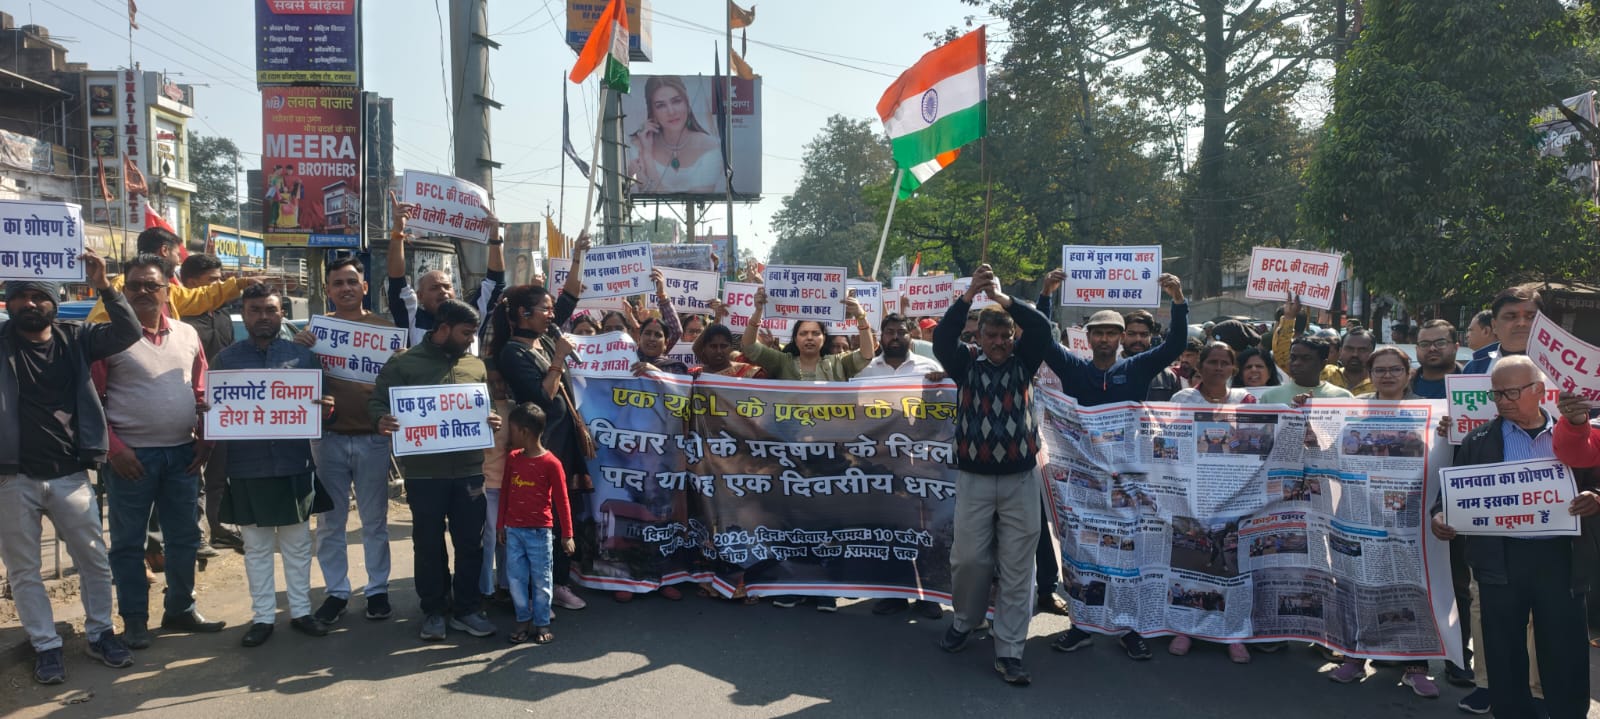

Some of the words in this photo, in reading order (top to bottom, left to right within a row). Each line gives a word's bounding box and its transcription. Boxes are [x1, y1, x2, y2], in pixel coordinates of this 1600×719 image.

[266, 134, 356, 159] MEERA
[298, 162, 356, 178] BROTHERS
[416, 182, 444, 200] BFCL
[446, 186, 457, 202] की
[3, 218, 22, 235] का
[24, 214, 64, 236] शोषण
[64, 216, 76, 237] हैं
[0, 250, 19, 268] का
[22, 251, 64, 275] प्रदूषण
[64, 248, 76, 269] हैं
[1070, 252, 1084, 262] हवा
[1088, 250, 1096, 261] में
[1097, 252, 1112, 265] घुल
[1115, 252, 1132, 262] गया
[1135, 252, 1155, 262] जहर
[598, 266, 620, 277] इसका
[621, 262, 645, 275] BFCL
[1094, 267, 1106, 280] जो
[1108, 269, 1138, 280] BFCL
[1142, 268, 1152, 280] के
[1262, 258, 1288, 272] BFCL
[1290, 258, 1302, 272] की
[1302, 262, 1329, 277] दलाली
[593, 282, 603, 292] का
[606, 280, 630, 293] प्रदूषण
[666, 278, 680, 288] एक
[683, 280, 698, 293] युद्ध
[792, 272, 805, 284] घुल
[807, 273, 822, 282] गया
[824, 274, 841, 282] जहर
[789, 286, 799, 298] जो
[801, 288, 827, 299] BFCL
[830, 288, 838, 299] के
[909, 284, 934, 296] BFCL
[1076, 288, 1105, 302] प्रदूषण
[1108, 288, 1120, 298] का
[1122, 288, 1142, 299] कहर
[1252, 277, 1266, 291] नही
[1308, 284, 1330, 300] चलेगी
[678, 295, 686, 306] के
[727, 292, 753, 306] BFC
[776, 304, 799, 315] प्रदूषण
[802, 306, 812, 314] का
[814, 306, 832, 315] कहर
[331, 329, 350, 348] युद्ध
[353, 331, 386, 351] BFCL
[390, 334, 401, 350] के
[1537, 328, 1588, 374] BFCL
[318, 353, 347, 372] दूषण
[349, 354, 359, 371] के
[213, 380, 266, 404] ट्रांसपोर्ट
[270, 380, 314, 400] विभाग
[397, 398, 415, 413] एक
[417, 396, 436, 418] युद्ध
[440, 393, 473, 411] BFCL
[474, 389, 484, 408] के
[612, 387, 658, 408] एक
[736, 396, 766, 418] के
[774, 403, 856, 427] प्रदूषण
[864, 400, 895, 419] के
[219, 405, 248, 427] होश
[253, 405, 265, 425] मे
[270, 405, 308, 425] आओ
[405, 425, 437, 447] प्रदूषण
[440, 420, 450, 439] के
[588, 418, 668, 455] बिहार
[707, 430, 737, 458] के
[745, 438, 837, 468] प्रदूषण
[844, 433, 878, 458] के
[600, 466, 648, 492] पद
[722, 474, 772, 497] एक
[779, 467, 894, 497] दिवसीय
[1450, 474, 1496, 490] मानवता
[1498, 472, 1515, 484] का
[1519, 468, 1554, 483] शोषण
[1457, 498, 1481, 509] नाम
[1484, 494, 1519, 509] इसका
[1522, 490, 1564, 506] BFCL
[1472, 517, 1489, 526] का
[1495, 514, 1534, 529] प्रदूषण
[874, 528, 893, 543] 10
[894, 547, 918, 560] तक
